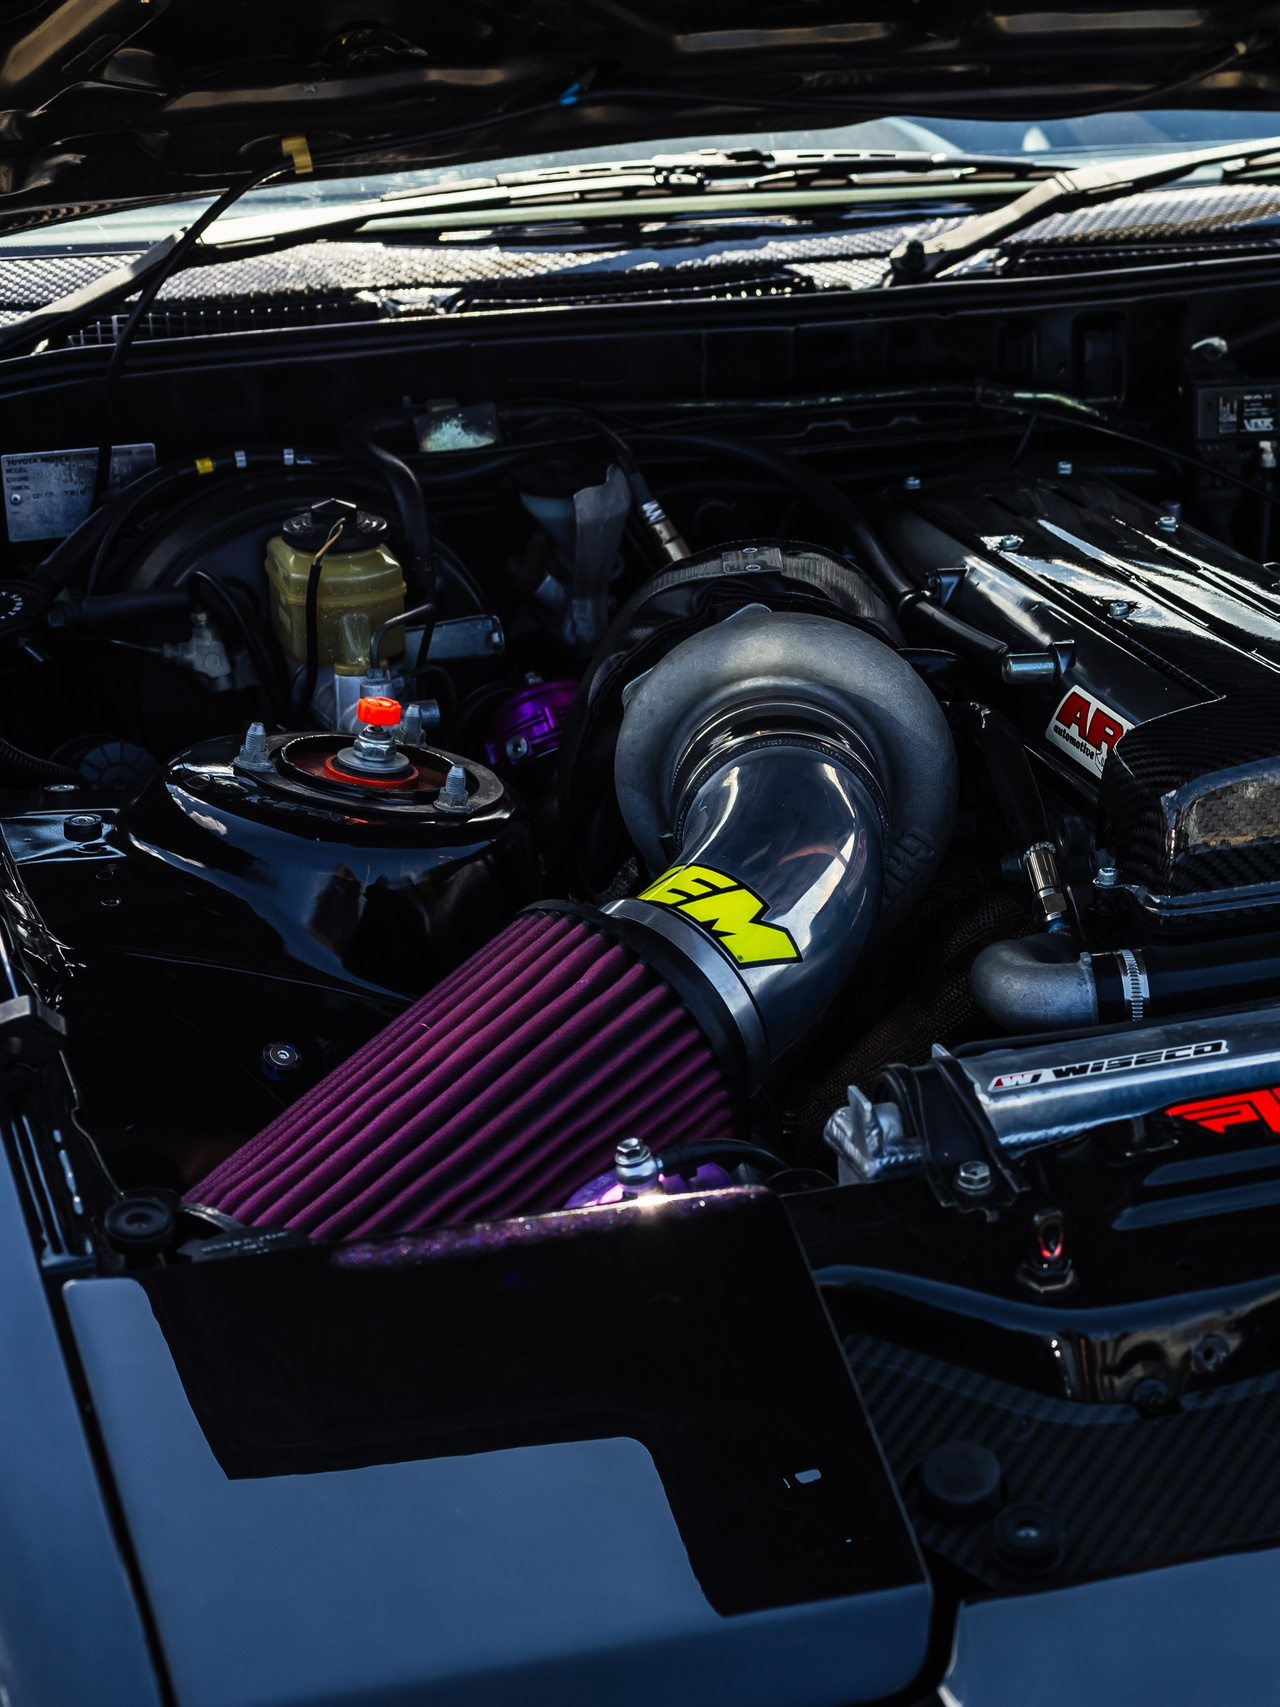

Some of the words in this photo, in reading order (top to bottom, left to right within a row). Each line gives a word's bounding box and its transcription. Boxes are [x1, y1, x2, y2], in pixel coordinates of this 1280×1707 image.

[6, 457, 37, 466] TOYOTA
[1053, 724, 1095, 760] automotive
[637, 864, 799, 964] EM
[1052, 1040, 1226, 1080] WISECO
